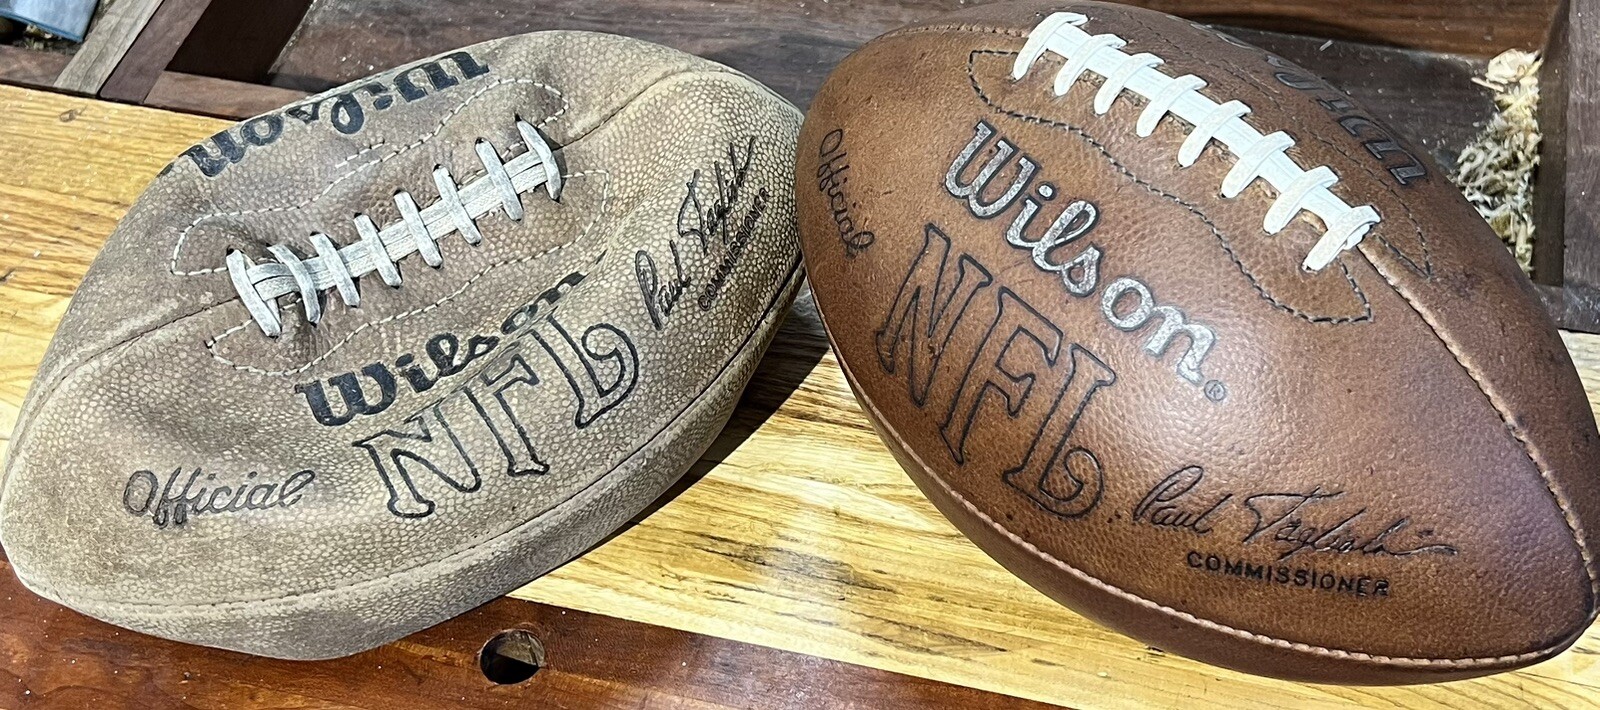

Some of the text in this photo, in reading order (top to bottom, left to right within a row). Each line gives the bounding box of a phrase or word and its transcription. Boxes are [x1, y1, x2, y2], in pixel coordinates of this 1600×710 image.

[817, 127, 875, 259] Official
[635, 239, 692, 331] Paul
[699, 187, 771, 312] COMMISSIONER
[352, 306, 640, 519] NFL
[876, 222, 1116, 519] NFL
[123, 467, 315, 528] Official
[1133, 465, 1232, 534] Paul
[1187, 551, 1390, 597] COMMISSIONER
